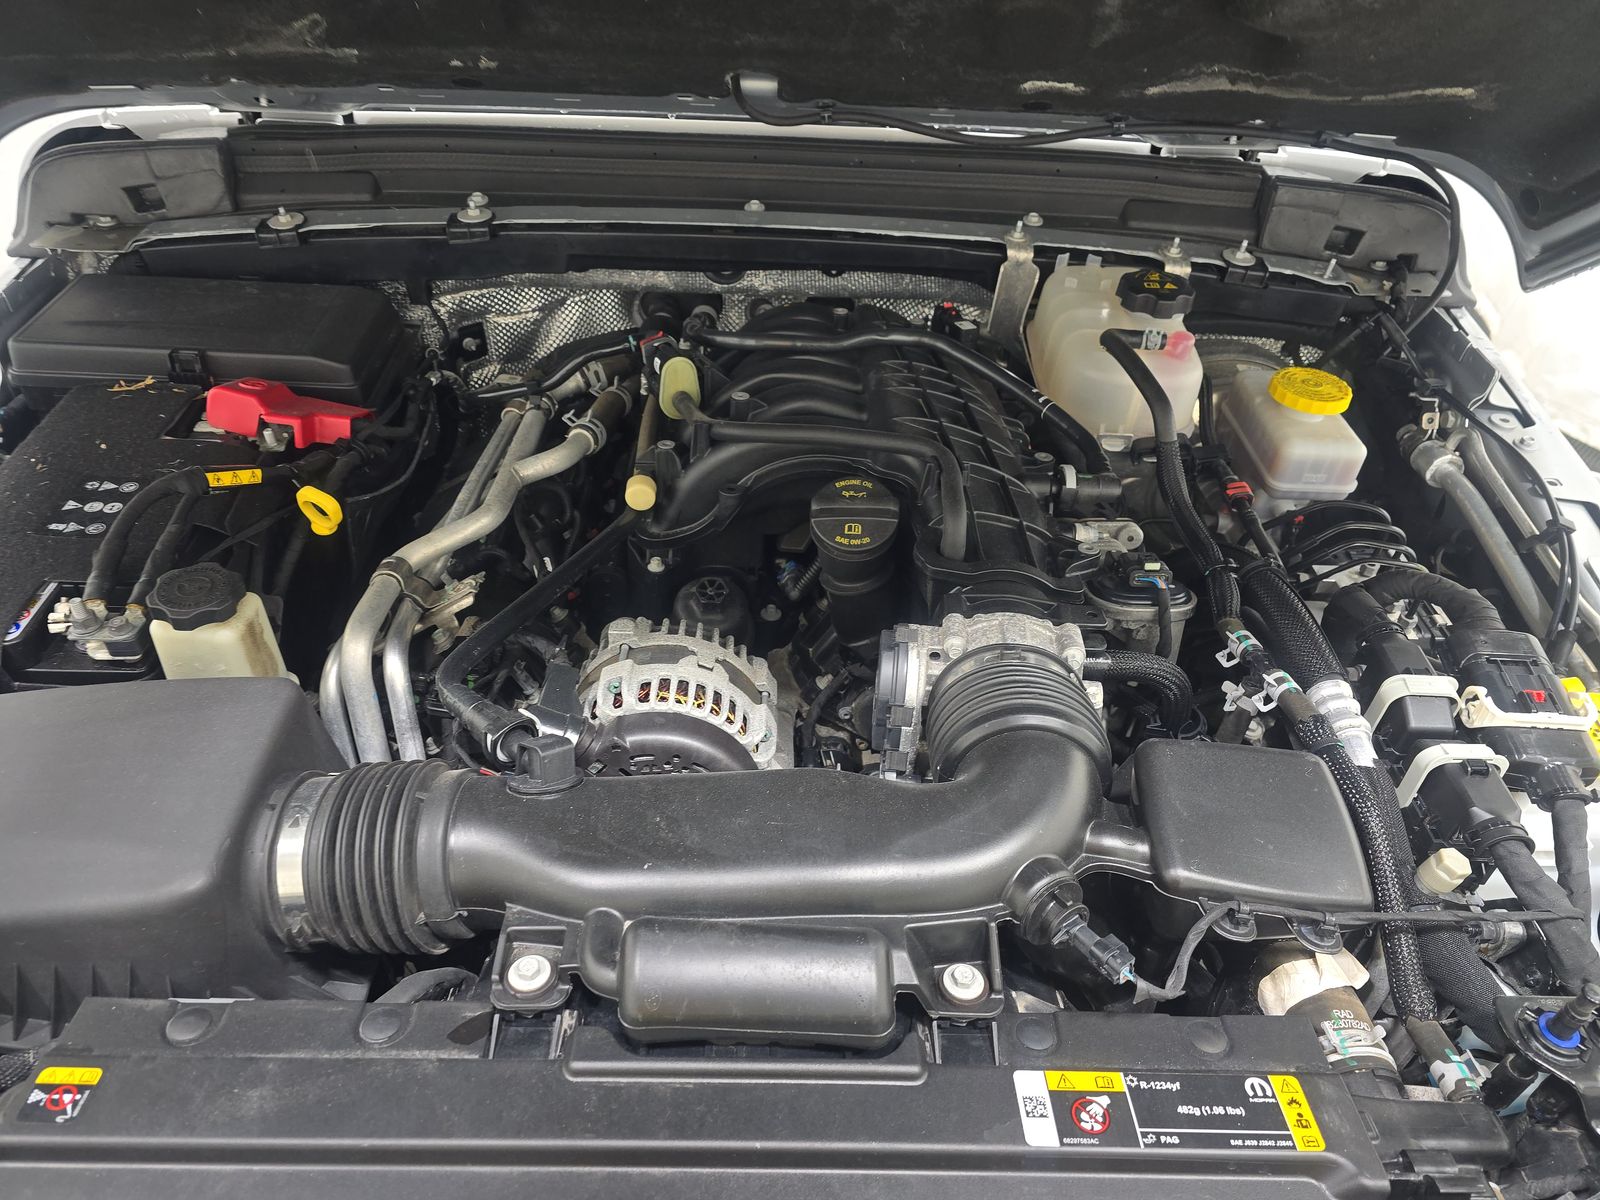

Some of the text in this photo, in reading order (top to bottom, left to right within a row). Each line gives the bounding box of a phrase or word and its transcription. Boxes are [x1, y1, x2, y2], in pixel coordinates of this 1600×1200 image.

[835, 480, 873, 489] ENGINE OIL
[834, 536, 871, 545] SAE 0W-20
[1332, 1009, 1354, 1019] RAD
[1139, 1080, 1181, 1092] R-1234yf
[1176, 1105, 1246, 1117] 482g (1.06 lbs)
[1159, 1135, 1180, 1145] PAG
